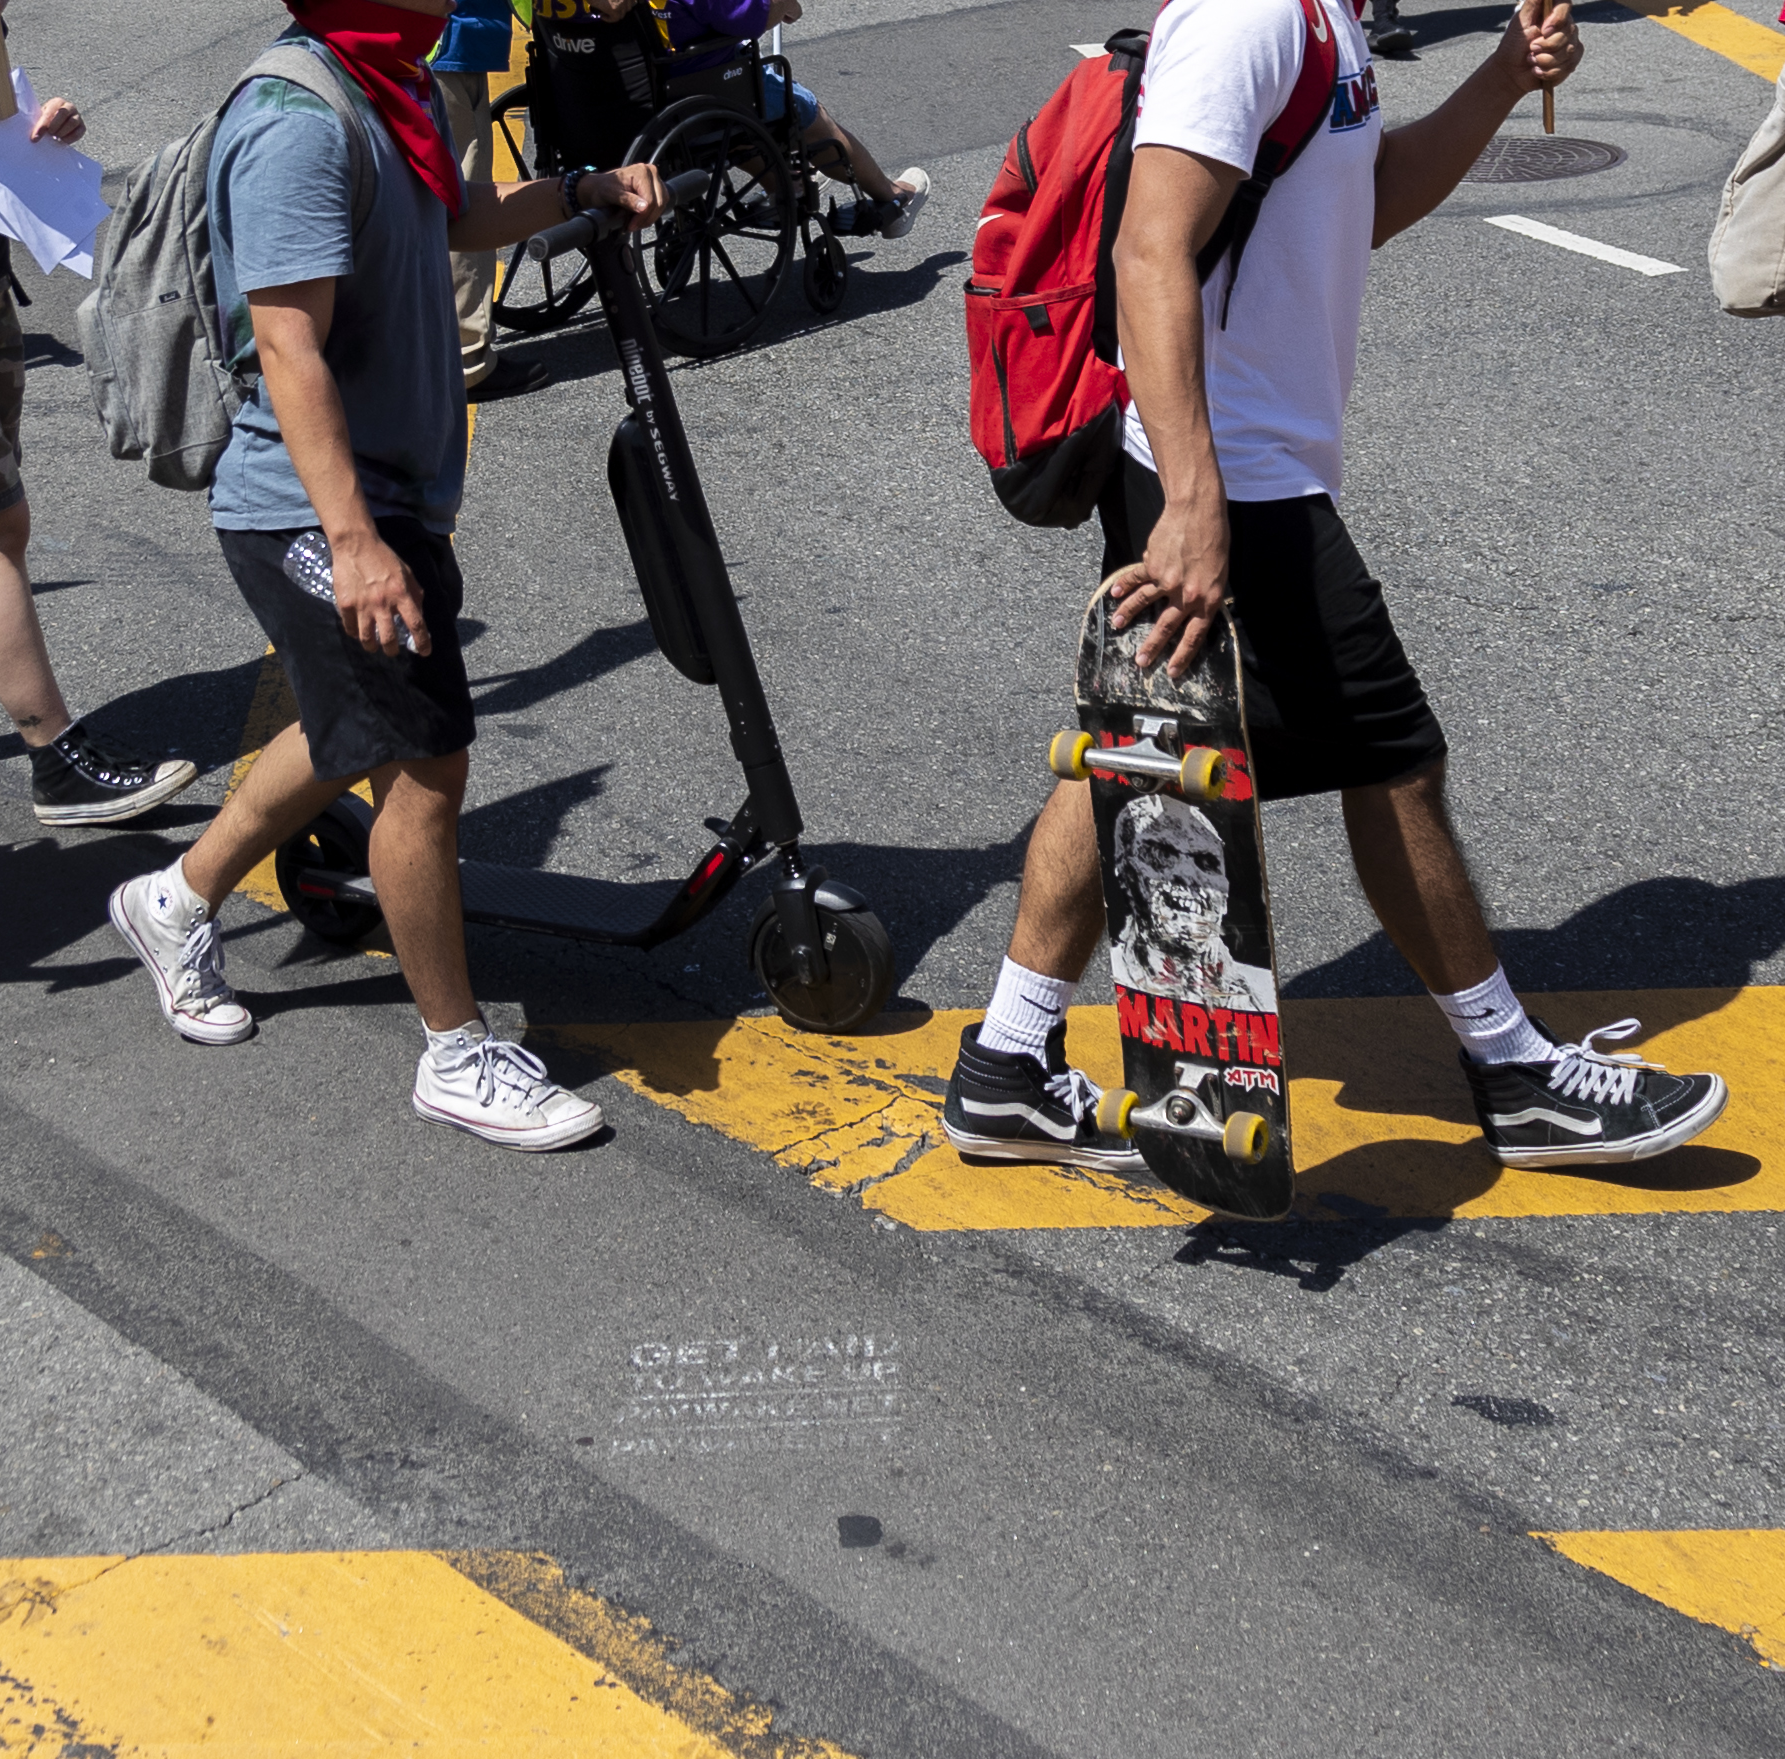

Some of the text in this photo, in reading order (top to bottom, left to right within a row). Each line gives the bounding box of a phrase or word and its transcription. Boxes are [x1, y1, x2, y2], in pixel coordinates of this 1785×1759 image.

[553, 32, 596, 55] drive
[723, 67, 743, 80] drive
[620, 338, 679, 501] ninebot by SEGWAY
[1116, 984, 1281, 1067] MARTIN
[1224, 1066, 1279, 1095] ATM
